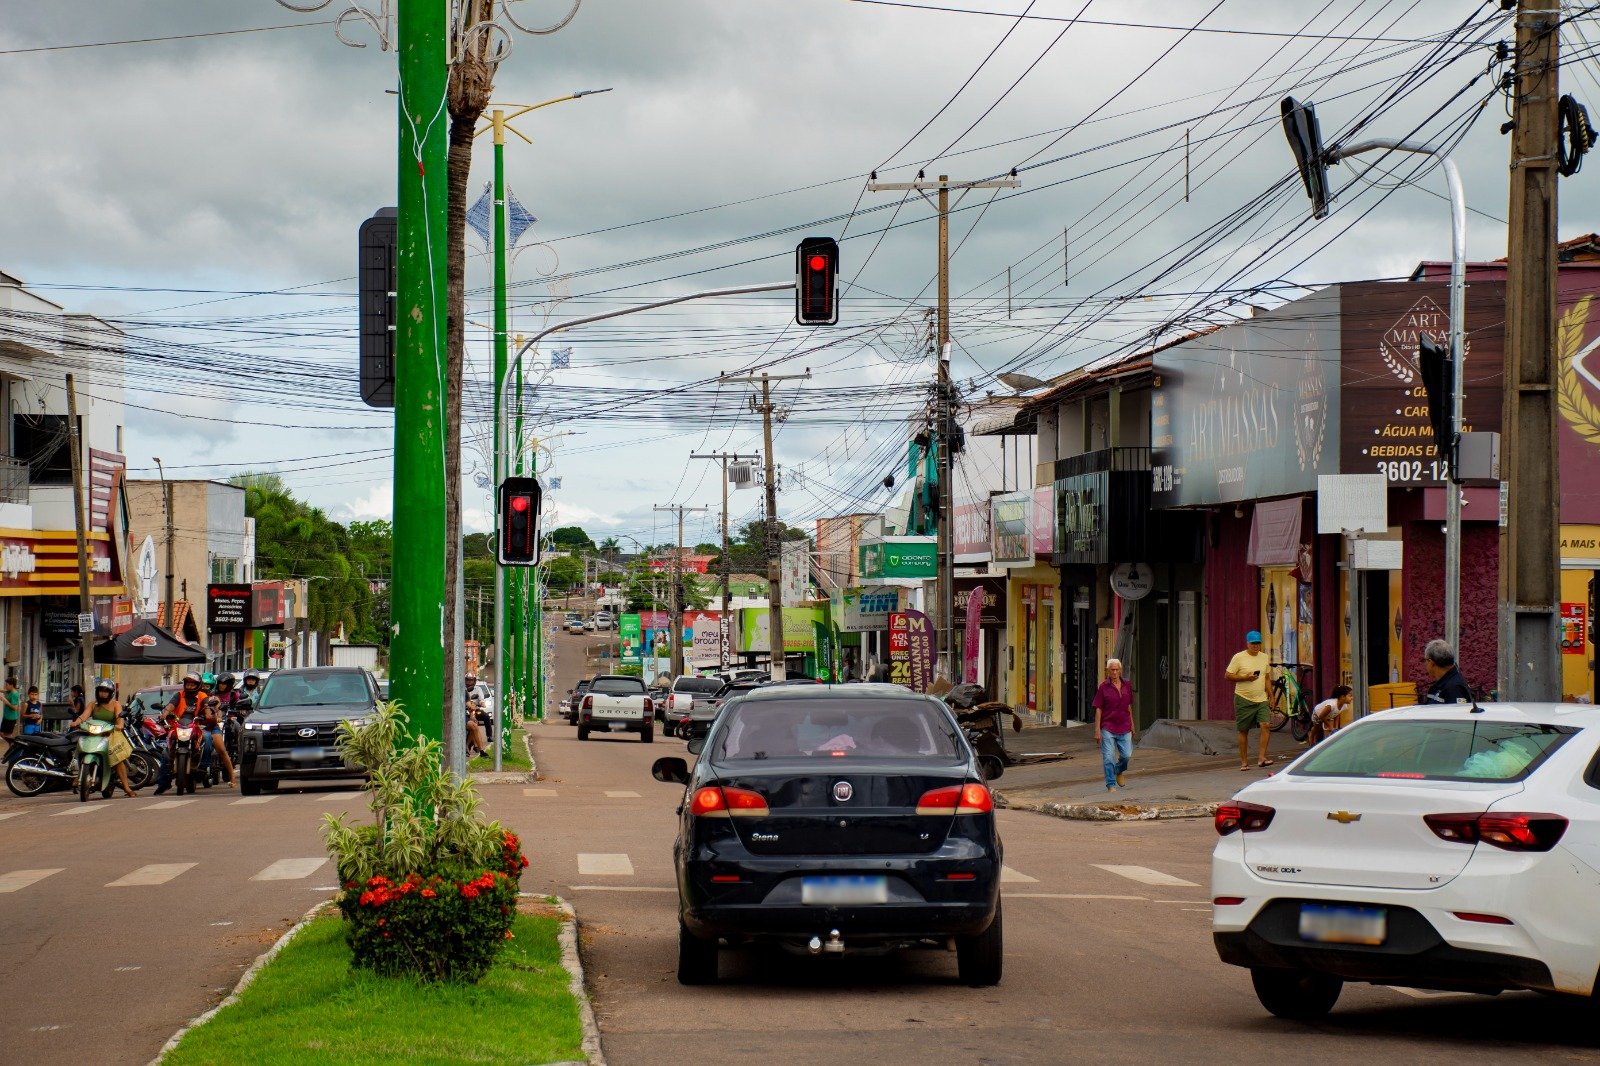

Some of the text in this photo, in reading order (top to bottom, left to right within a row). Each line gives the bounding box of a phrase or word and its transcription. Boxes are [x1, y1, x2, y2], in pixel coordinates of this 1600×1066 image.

[1407, 313, 1441, 327] ART
[1393, 330, 1450, 343] MASA
[1190, 382, 1279, 463] ART MASSAS
[1382, 424, 1417, 437] ÁGUA
[1370, 445, 1423, 457] BEBIDAS
[1570, 540, 1596, 549] MAIS
[908, 617, 926, 633] M
[694, 637, 720, 645] brown
[922, 635, 930, 657] 15,00
[751, 832, 779, 842] Siena
